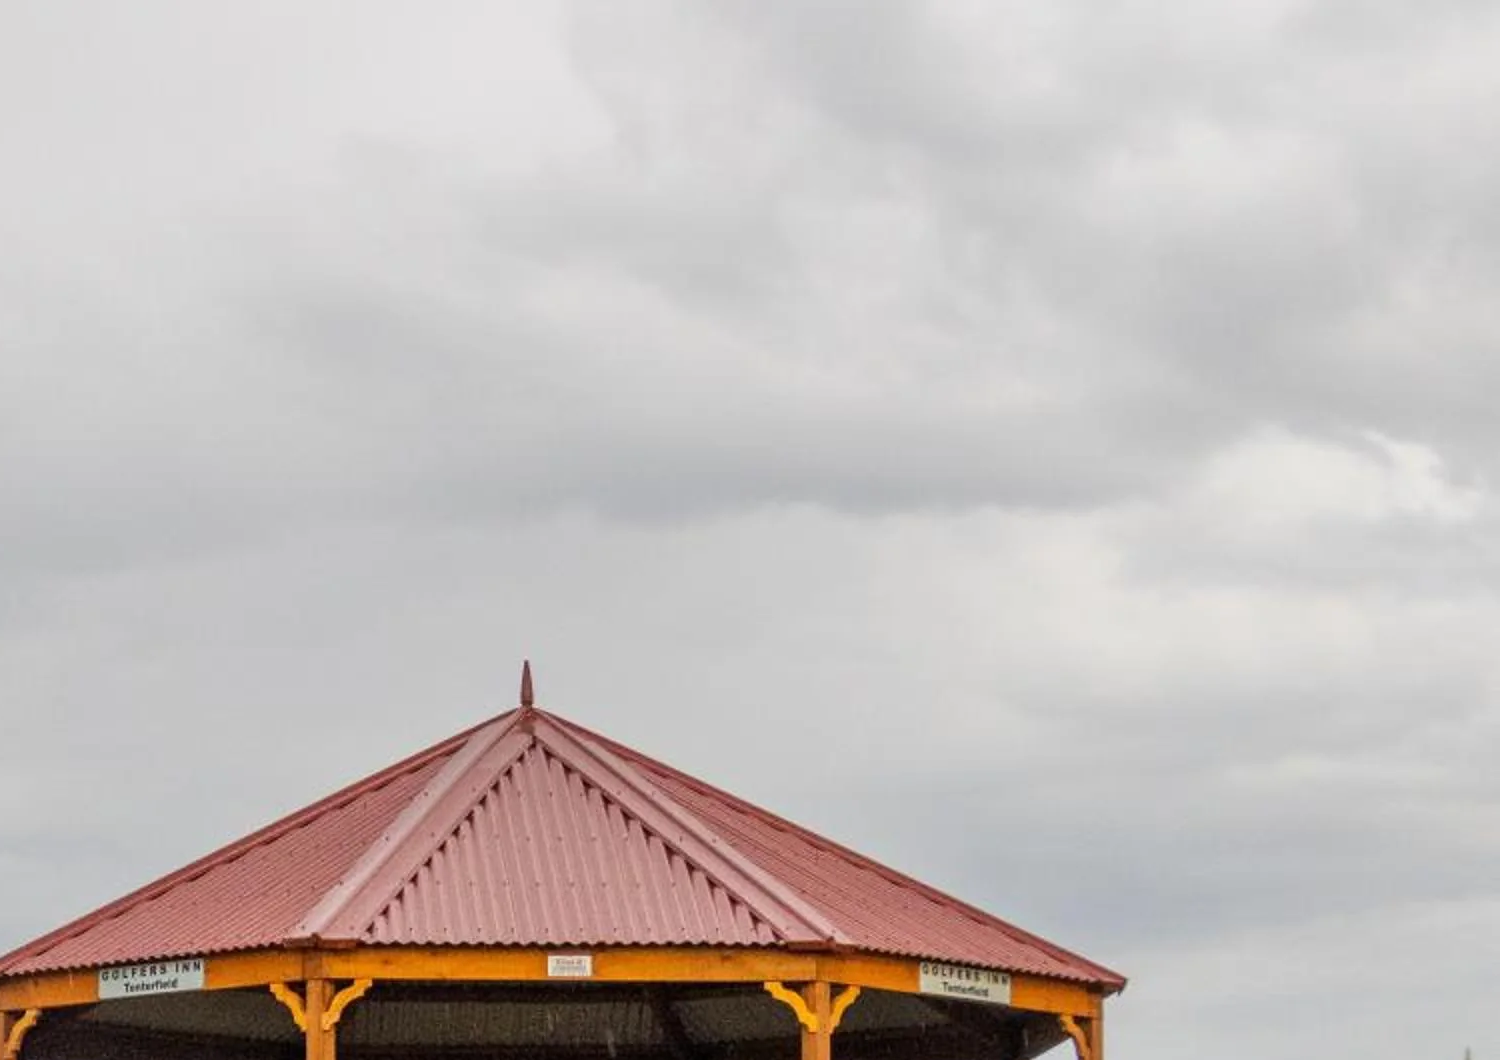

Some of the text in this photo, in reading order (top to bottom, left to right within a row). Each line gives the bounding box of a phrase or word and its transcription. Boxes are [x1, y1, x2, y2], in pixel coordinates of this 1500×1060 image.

[101, 960, 201, 980] GOLFERS INN
[123, 978, 178, 993] Tenterfield
